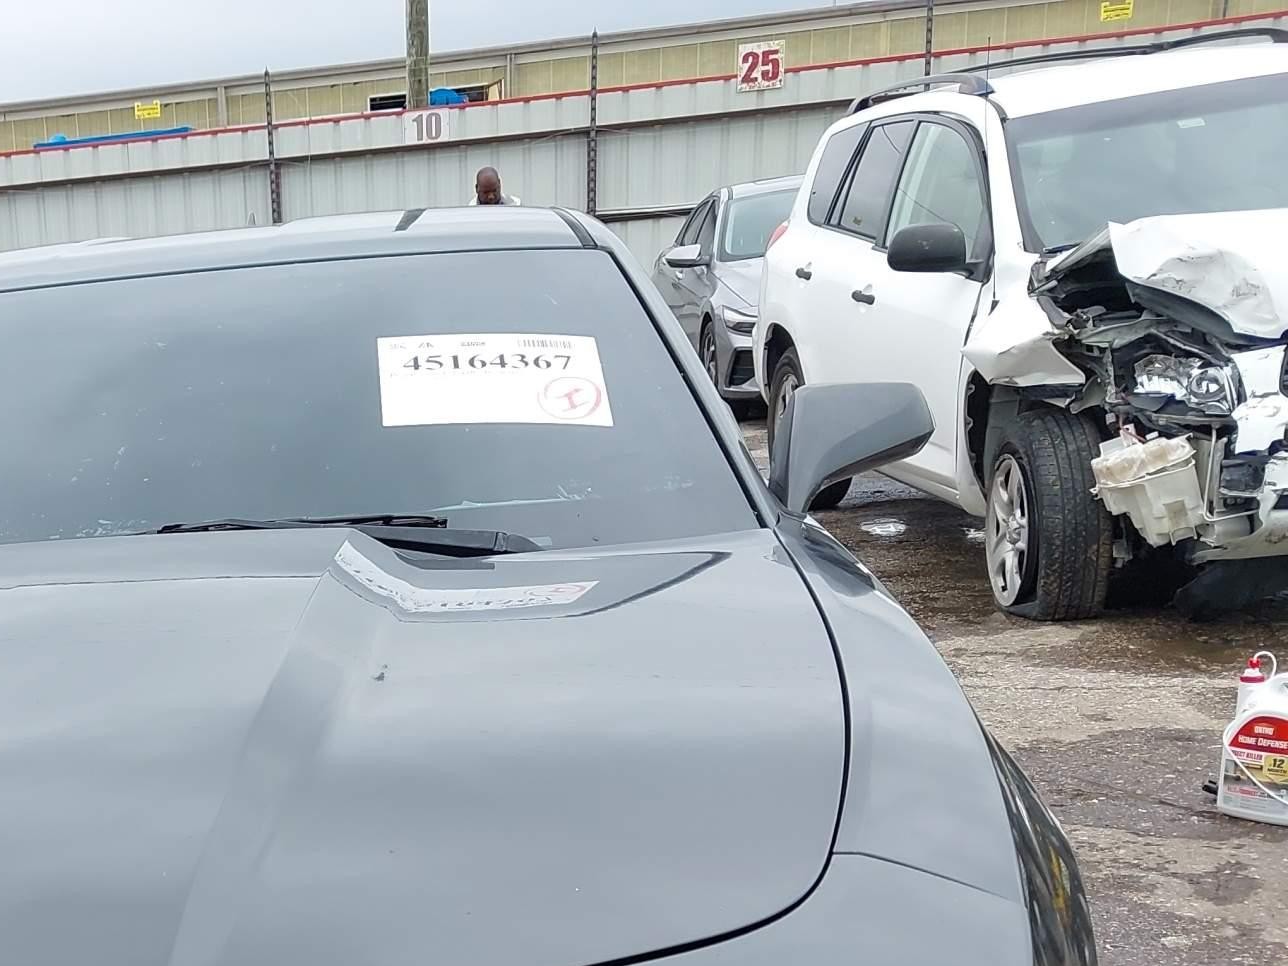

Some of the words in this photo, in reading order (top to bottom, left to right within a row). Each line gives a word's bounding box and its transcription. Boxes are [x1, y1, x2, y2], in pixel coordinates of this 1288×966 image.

[741, 48, 780, 84] 25
[412, 112, 442, 142] 10
[402, 353, 572, 371] 45164367
[1238, 734, 1257, 745] HOME
[1257, 737, 1288, 750] DEFENSE
[1272, 758, 1286, 769] 12
